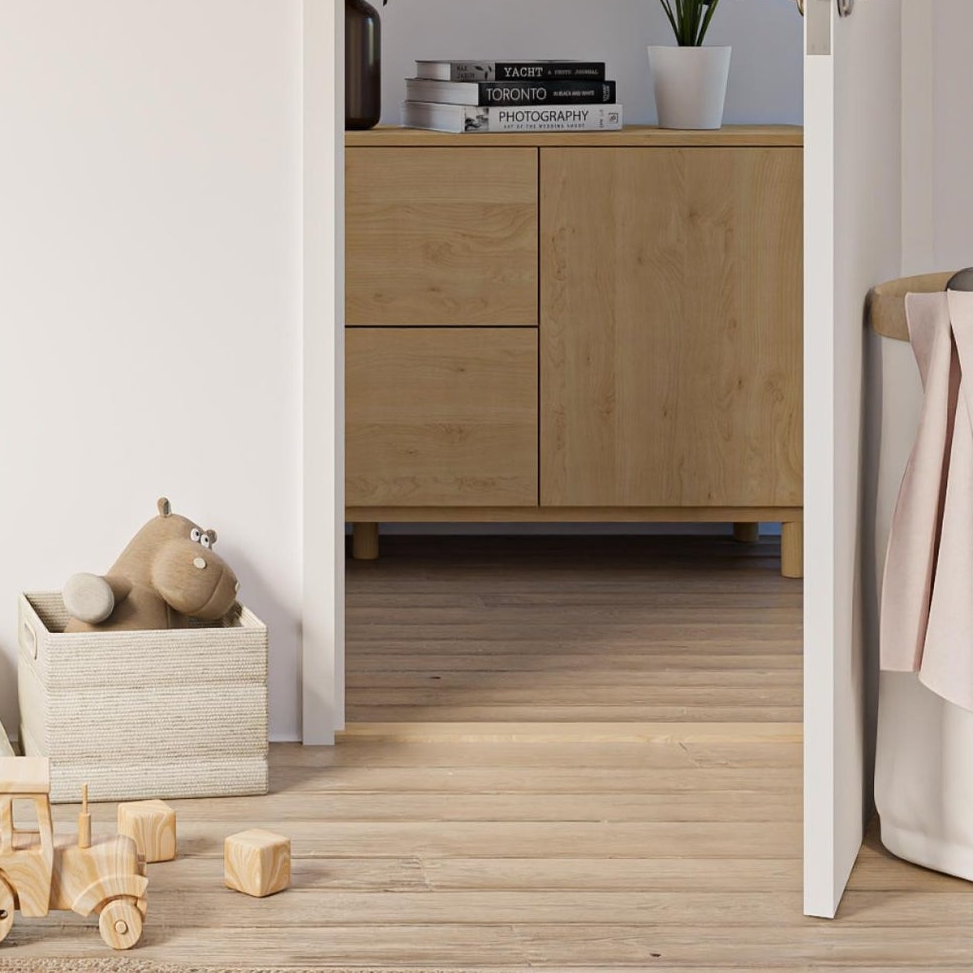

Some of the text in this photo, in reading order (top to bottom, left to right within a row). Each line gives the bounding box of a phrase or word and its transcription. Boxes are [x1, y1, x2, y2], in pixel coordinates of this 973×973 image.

[503, 66, 543, 77] YACHT
[486, 87, 547, 101] TORONTO
[499, 110, 589, 122] PHOTOGRAPHY
